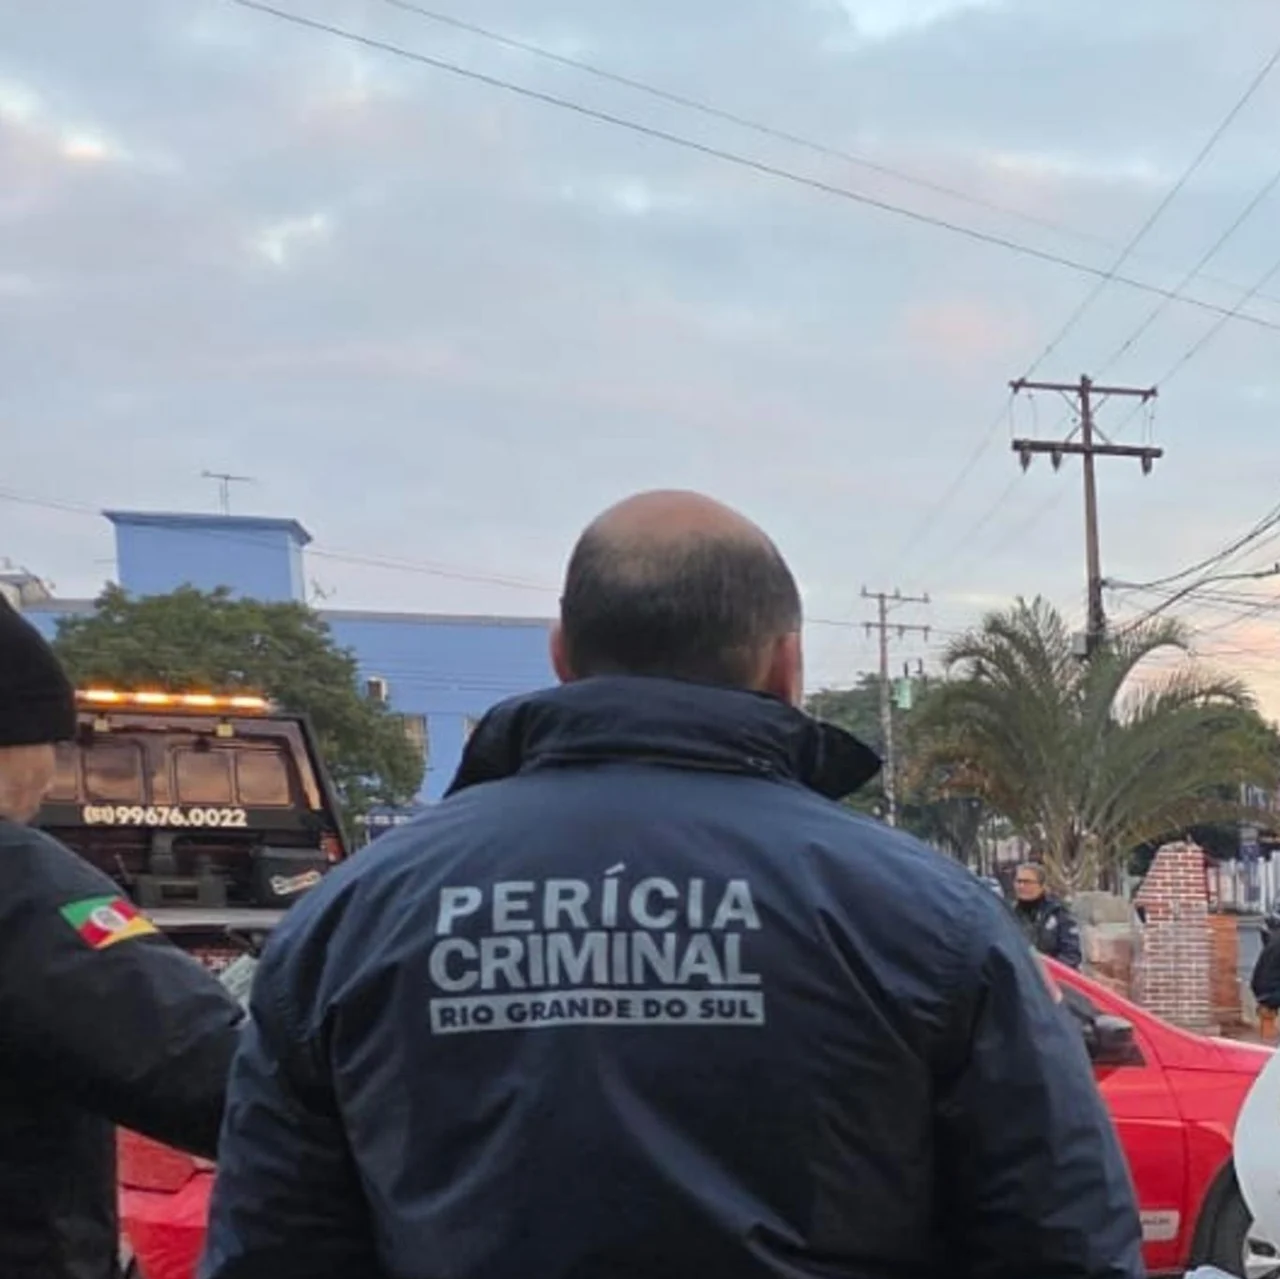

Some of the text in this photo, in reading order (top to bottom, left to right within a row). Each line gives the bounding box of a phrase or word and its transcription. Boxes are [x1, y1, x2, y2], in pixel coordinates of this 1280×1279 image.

[435, 862, 762, 935] PERÍCIA
[428, 930, 762, 992] CRIMINAL
[439, 996, 757, 1029] RIO GRANDE DO SUL
